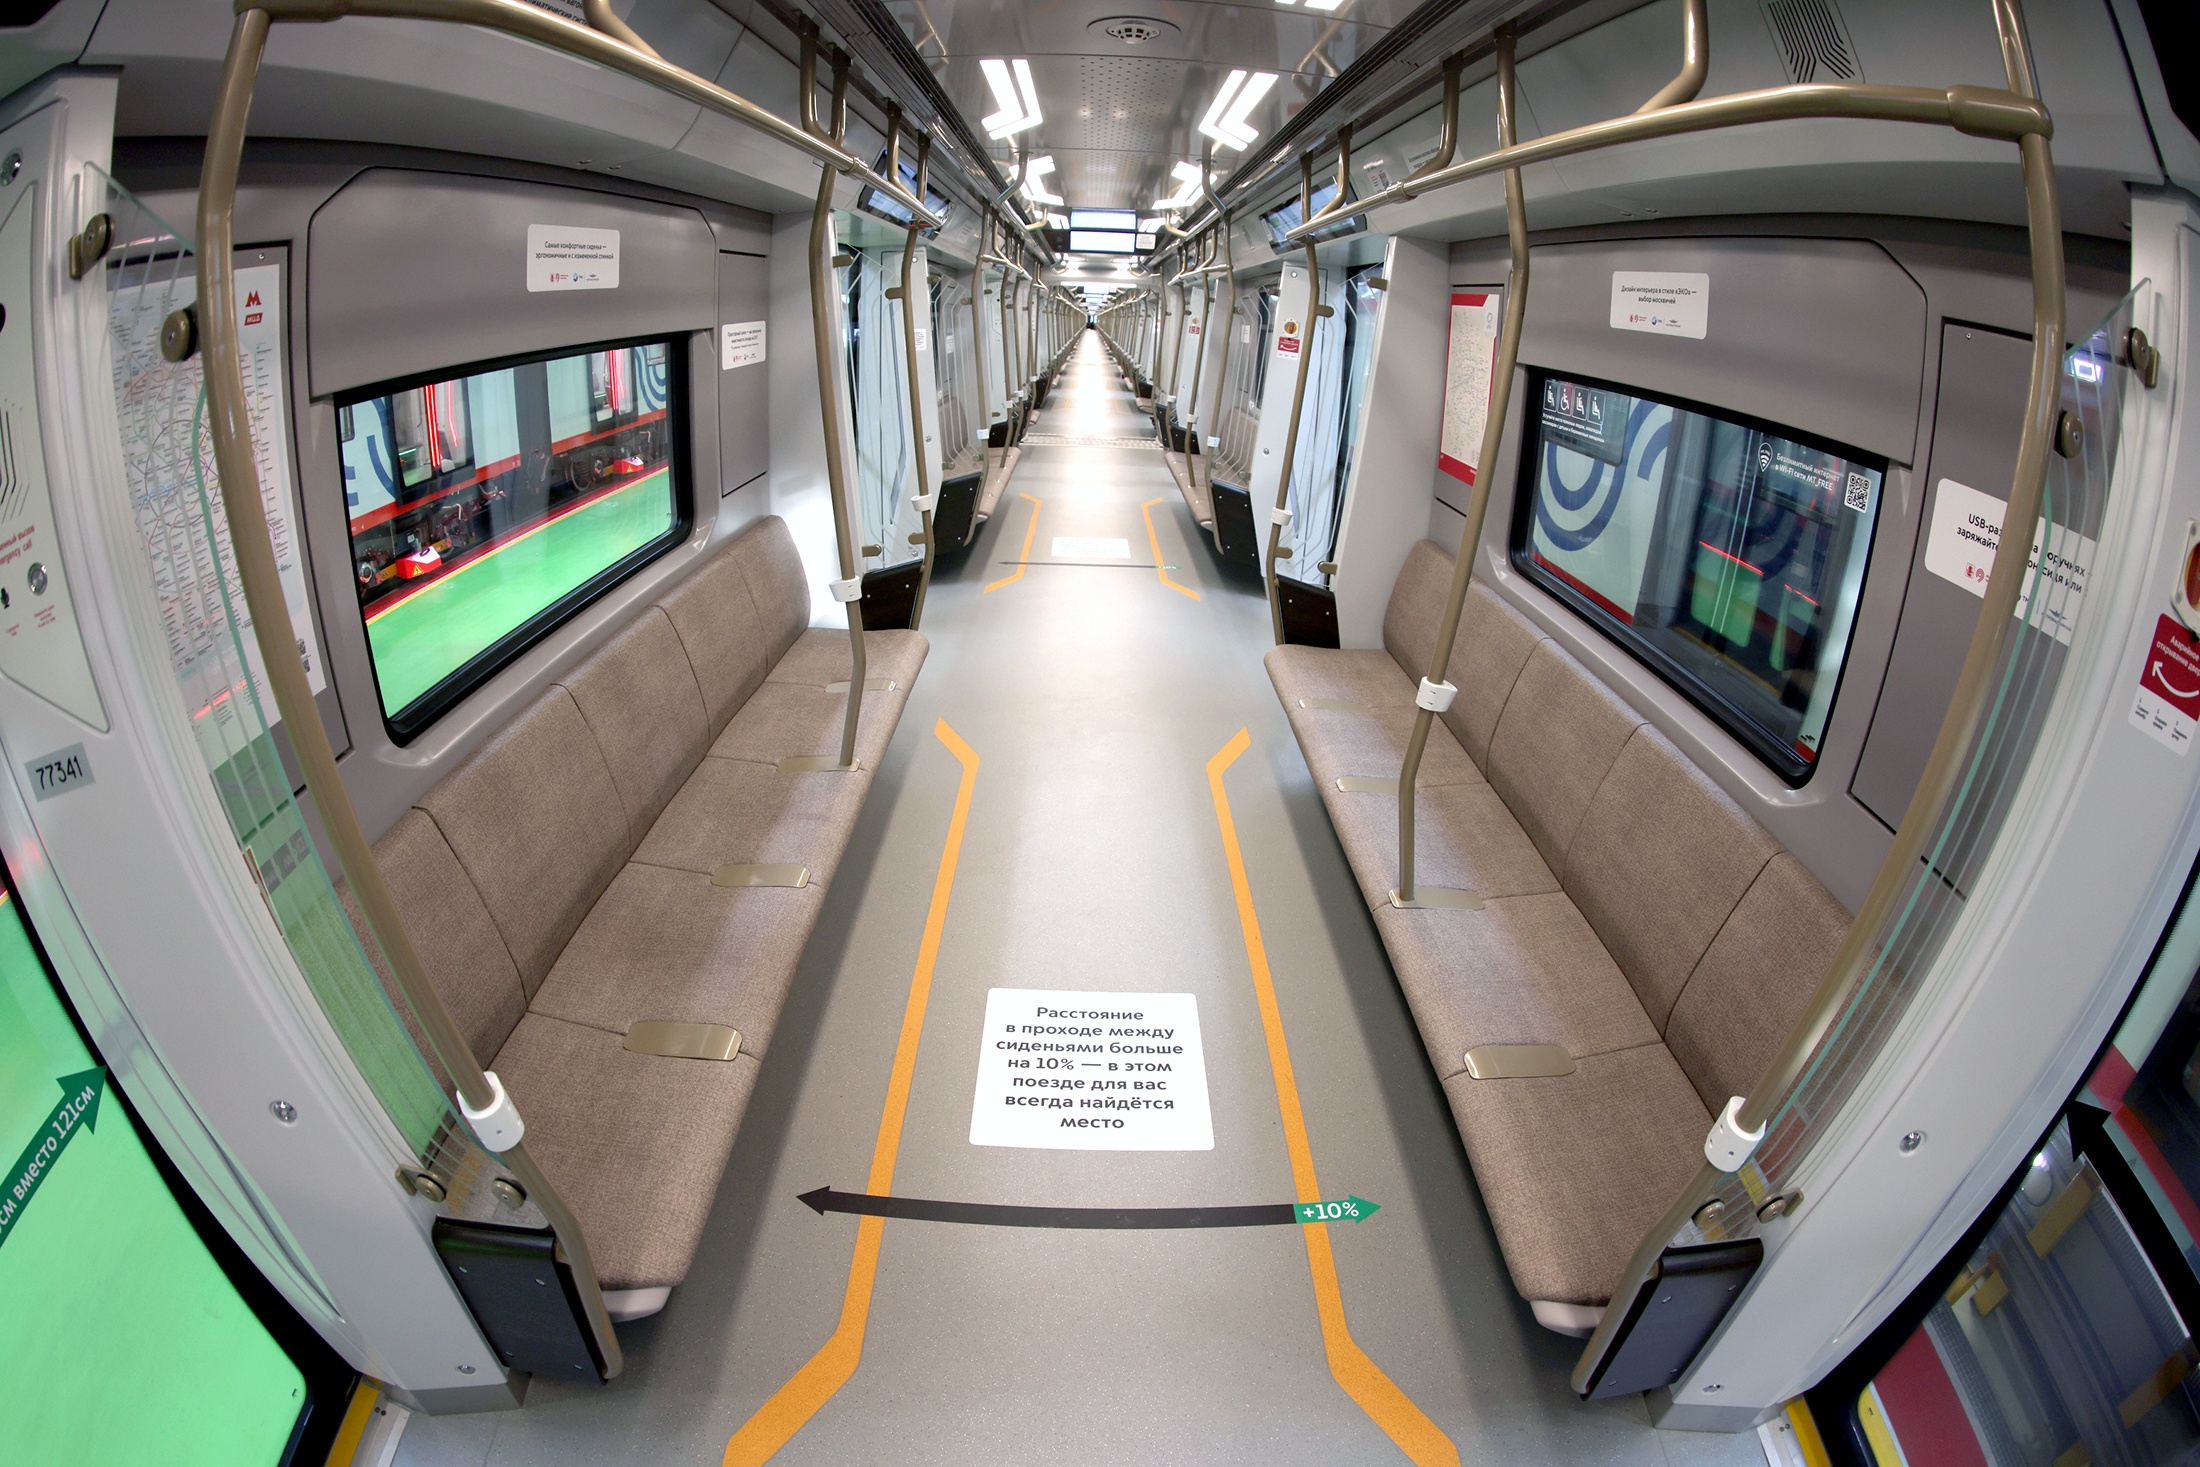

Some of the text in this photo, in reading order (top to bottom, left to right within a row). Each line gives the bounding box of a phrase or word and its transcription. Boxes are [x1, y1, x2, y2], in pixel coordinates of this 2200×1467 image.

[524, 0, 572, 18] лиматические
[1776, 452, 1840, 482] Безлимитный интернет
[1793, 470, 1806, 480] сети
[1806, 474, 1833, 491] MT_FREE
[1968, 513, 2002, 537] USB-раз
[2046, 552, 2086, 577] оручнях
[35, 755, 83, 790] 77341
[1036, 1006, 1144, 1021] Расстояние
[1005, 1024, 1175, 1040] в проходе между
[995, 1040, 1184, 1055] сиденьями больше
[1007, 1057, 1031, 1069] на
[1035, 1057, 1075, 1071] 10%
[1107, 1062, 1119, 1072] в
[1124, 1062, 1173, 1072] этом
[1012, 1076, 1168, 1092] поезде для вас
[1004, 1095, 1175, 1111] всегда найдётся
[1060, 1117, 1125, 1129] место
[12, 1135, 58, 1201] вместо
[51, 1085, 96, 1140] 121см
[1303, 1201, 1360, 1220] +10%
